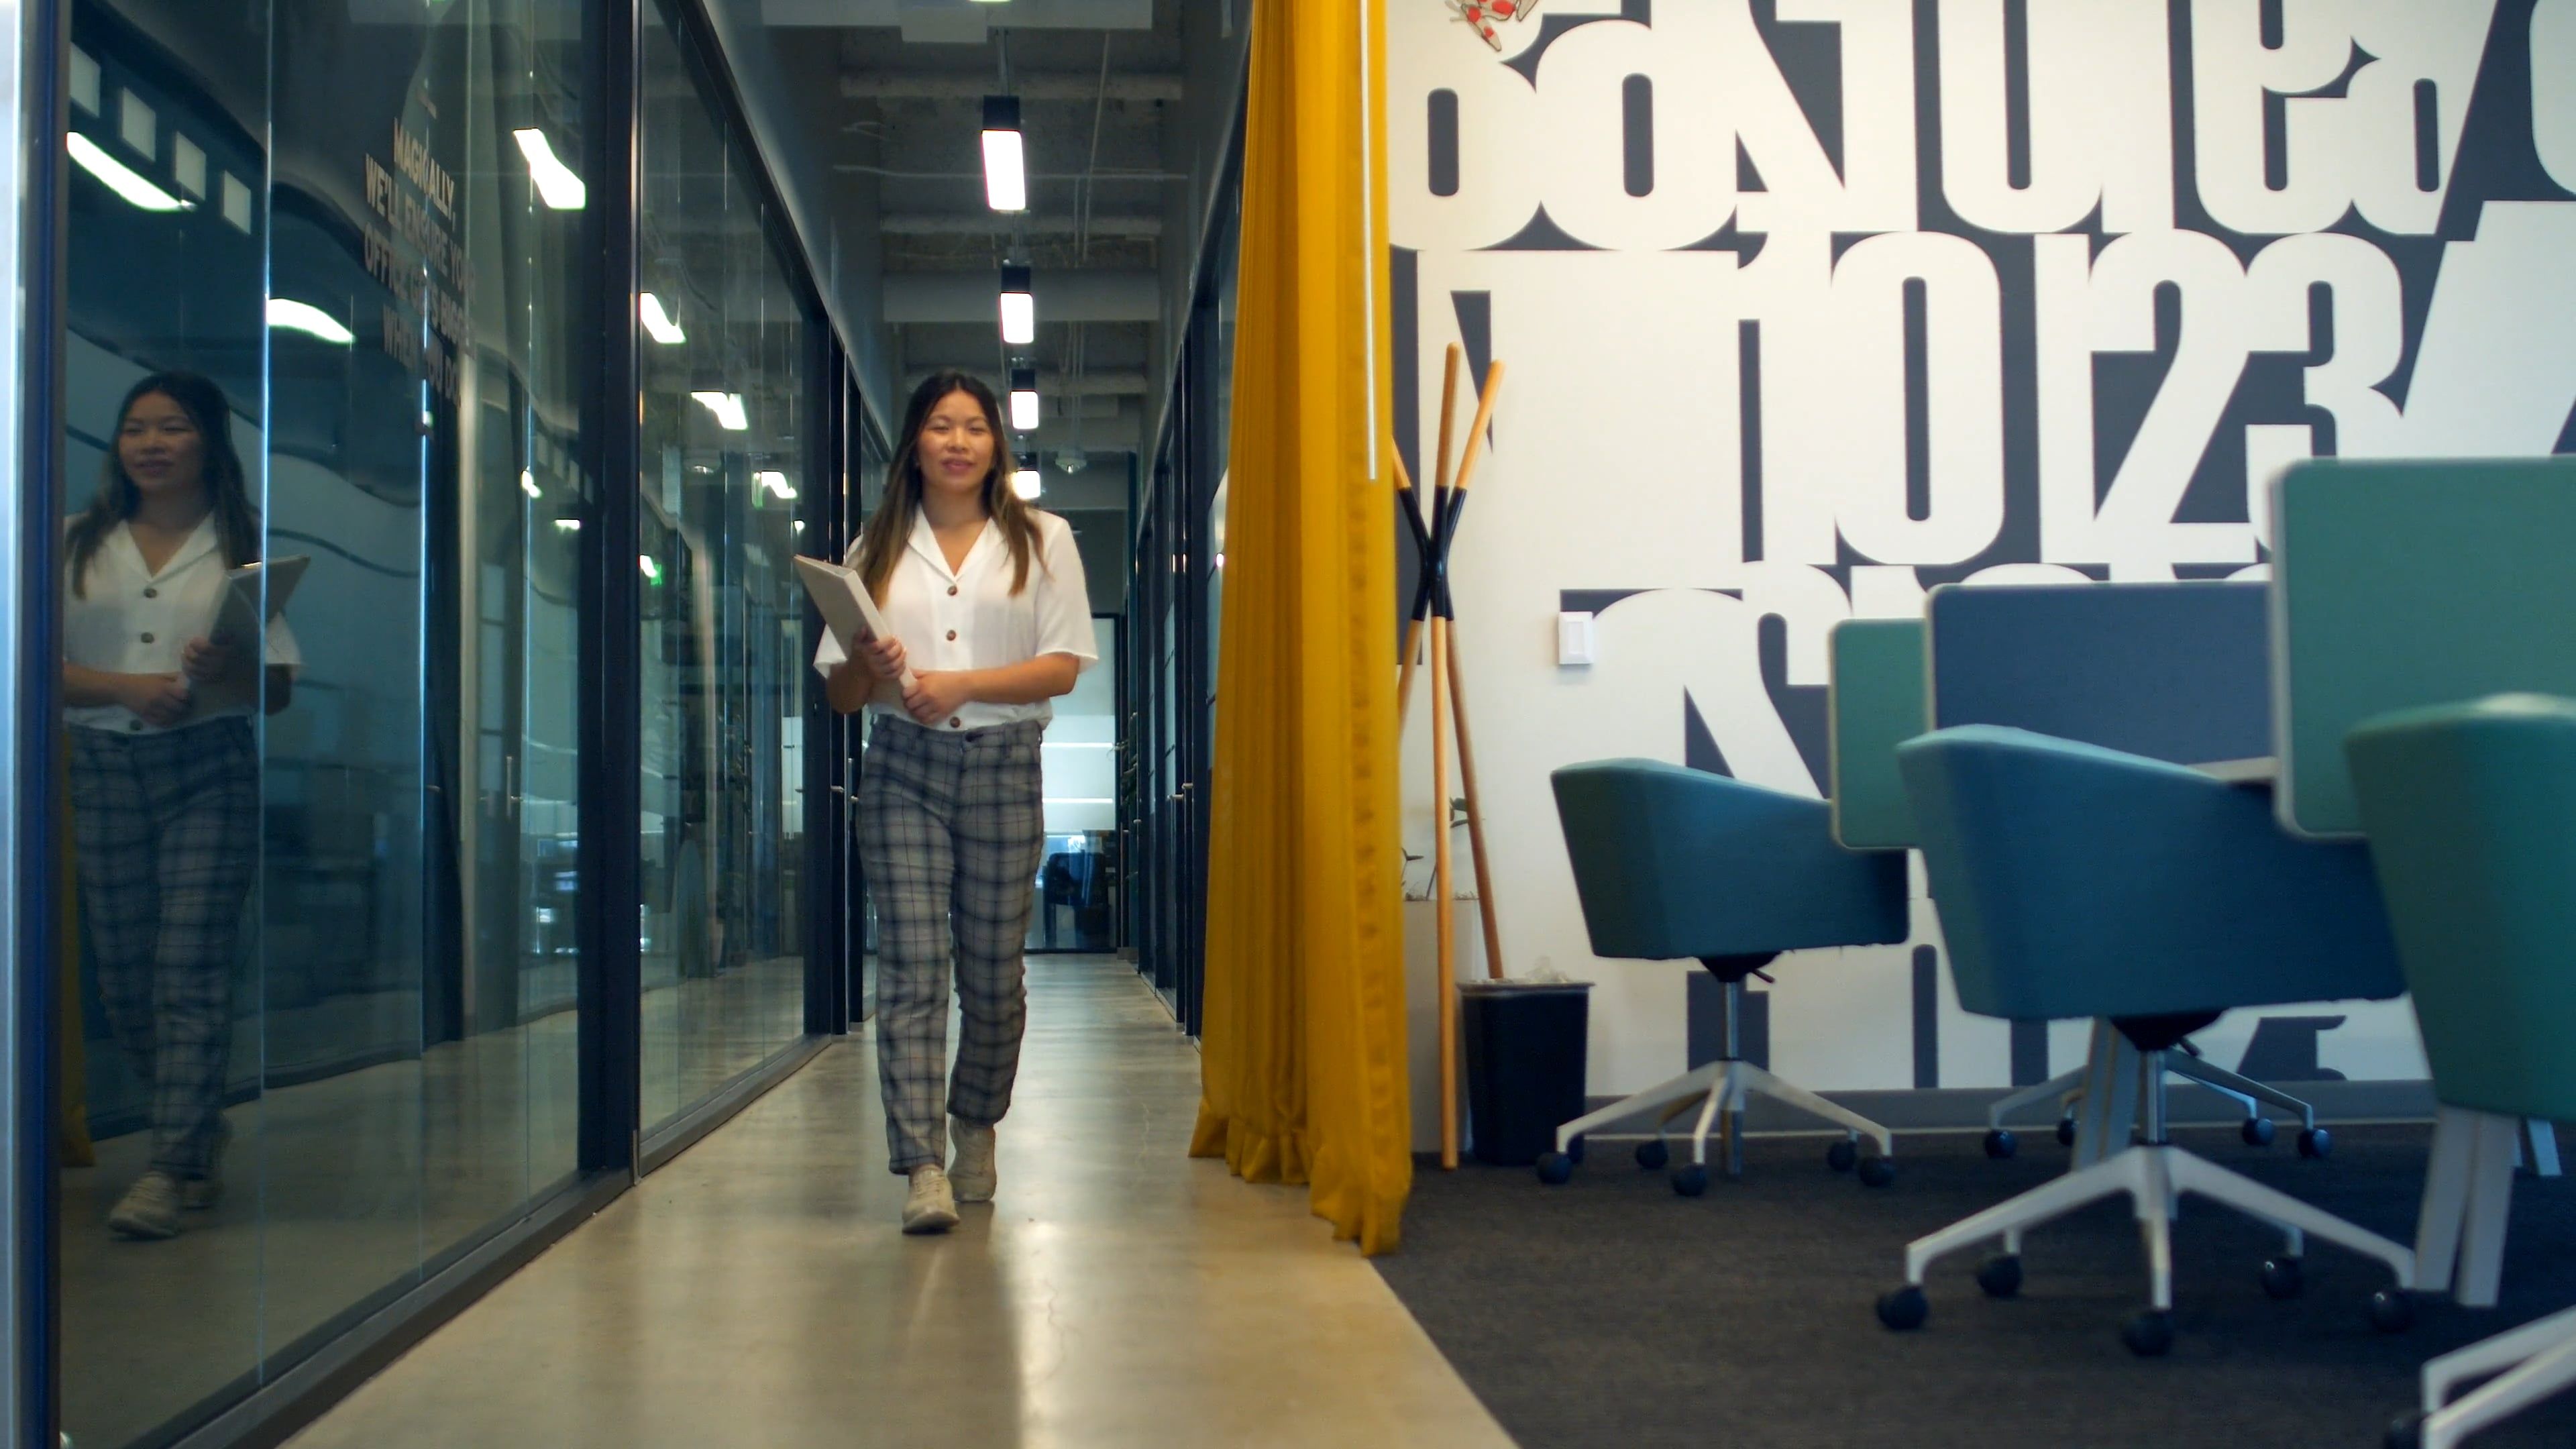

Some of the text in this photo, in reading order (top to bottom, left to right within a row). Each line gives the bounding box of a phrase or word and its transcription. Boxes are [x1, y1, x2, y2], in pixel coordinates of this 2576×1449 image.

[366, 152, 401, 233] WE'LL
[405, 193, 447, 276] ENSURE
[394, 117, 457, 232] MAGICALLY,
[411, 264, 439, 329] GES
[441, 290, 476, 360] BIGG
